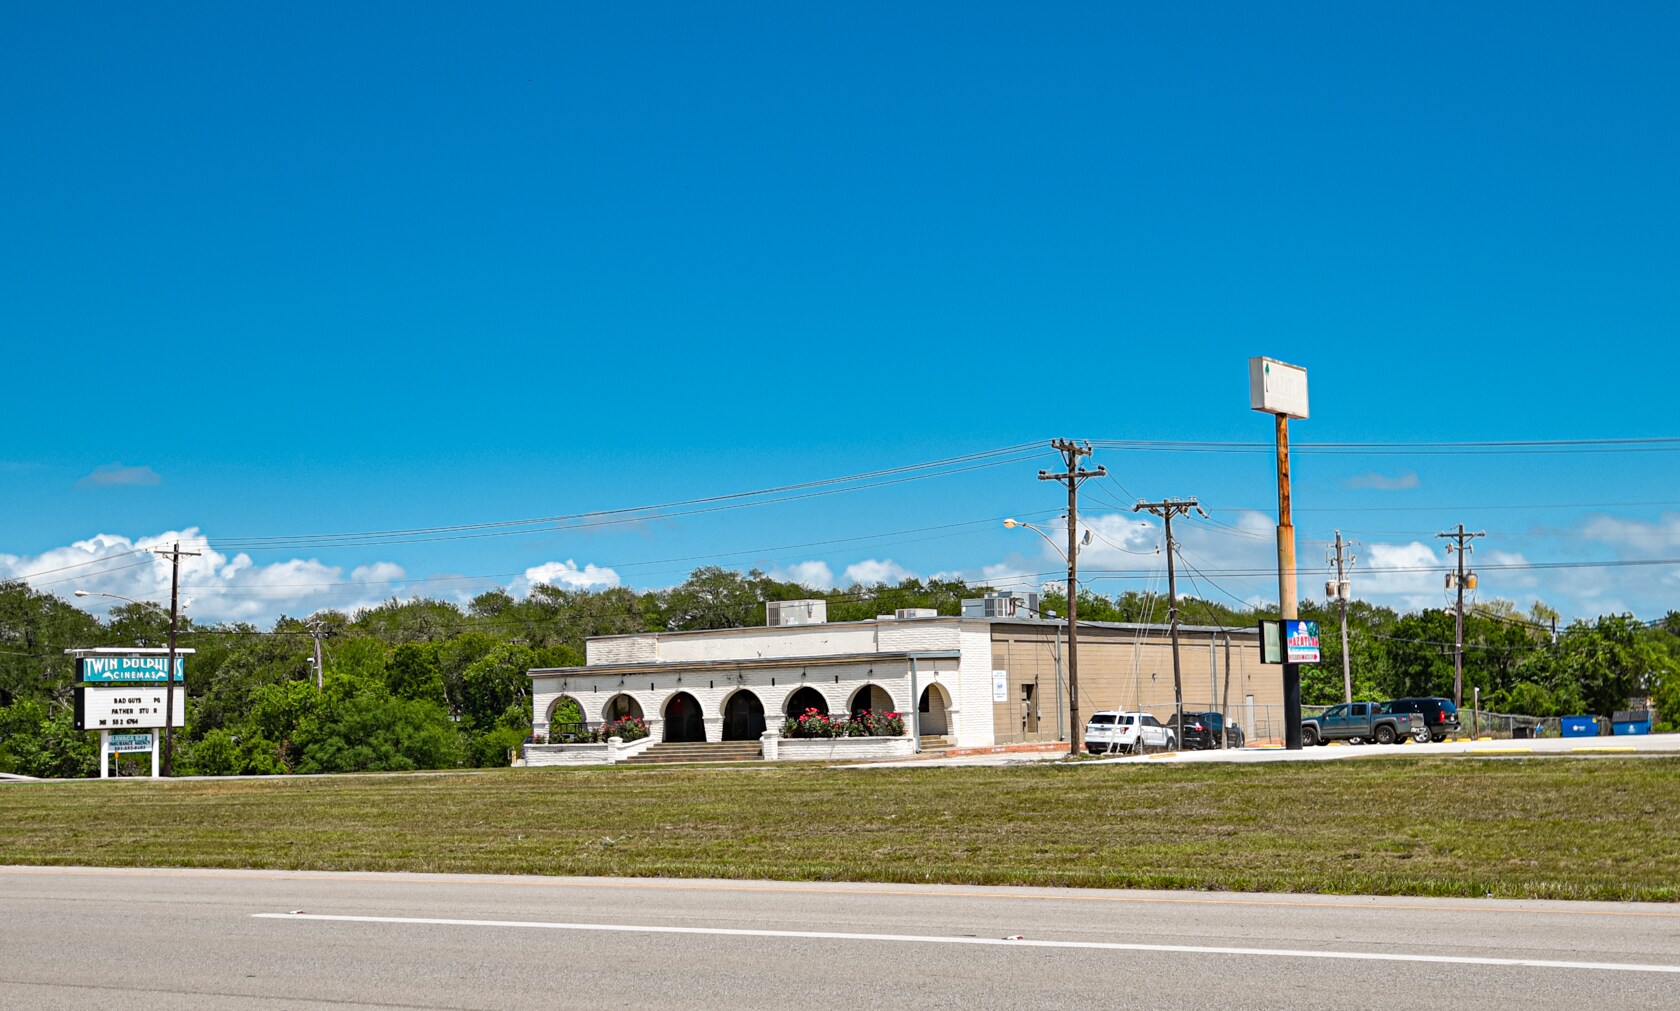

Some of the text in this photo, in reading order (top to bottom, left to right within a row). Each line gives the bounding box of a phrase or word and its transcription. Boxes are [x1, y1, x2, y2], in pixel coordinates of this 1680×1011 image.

[86, 658, 183, 676] TWIN DOLPHIS
[113, 671, 155, 679] CINEMAS
